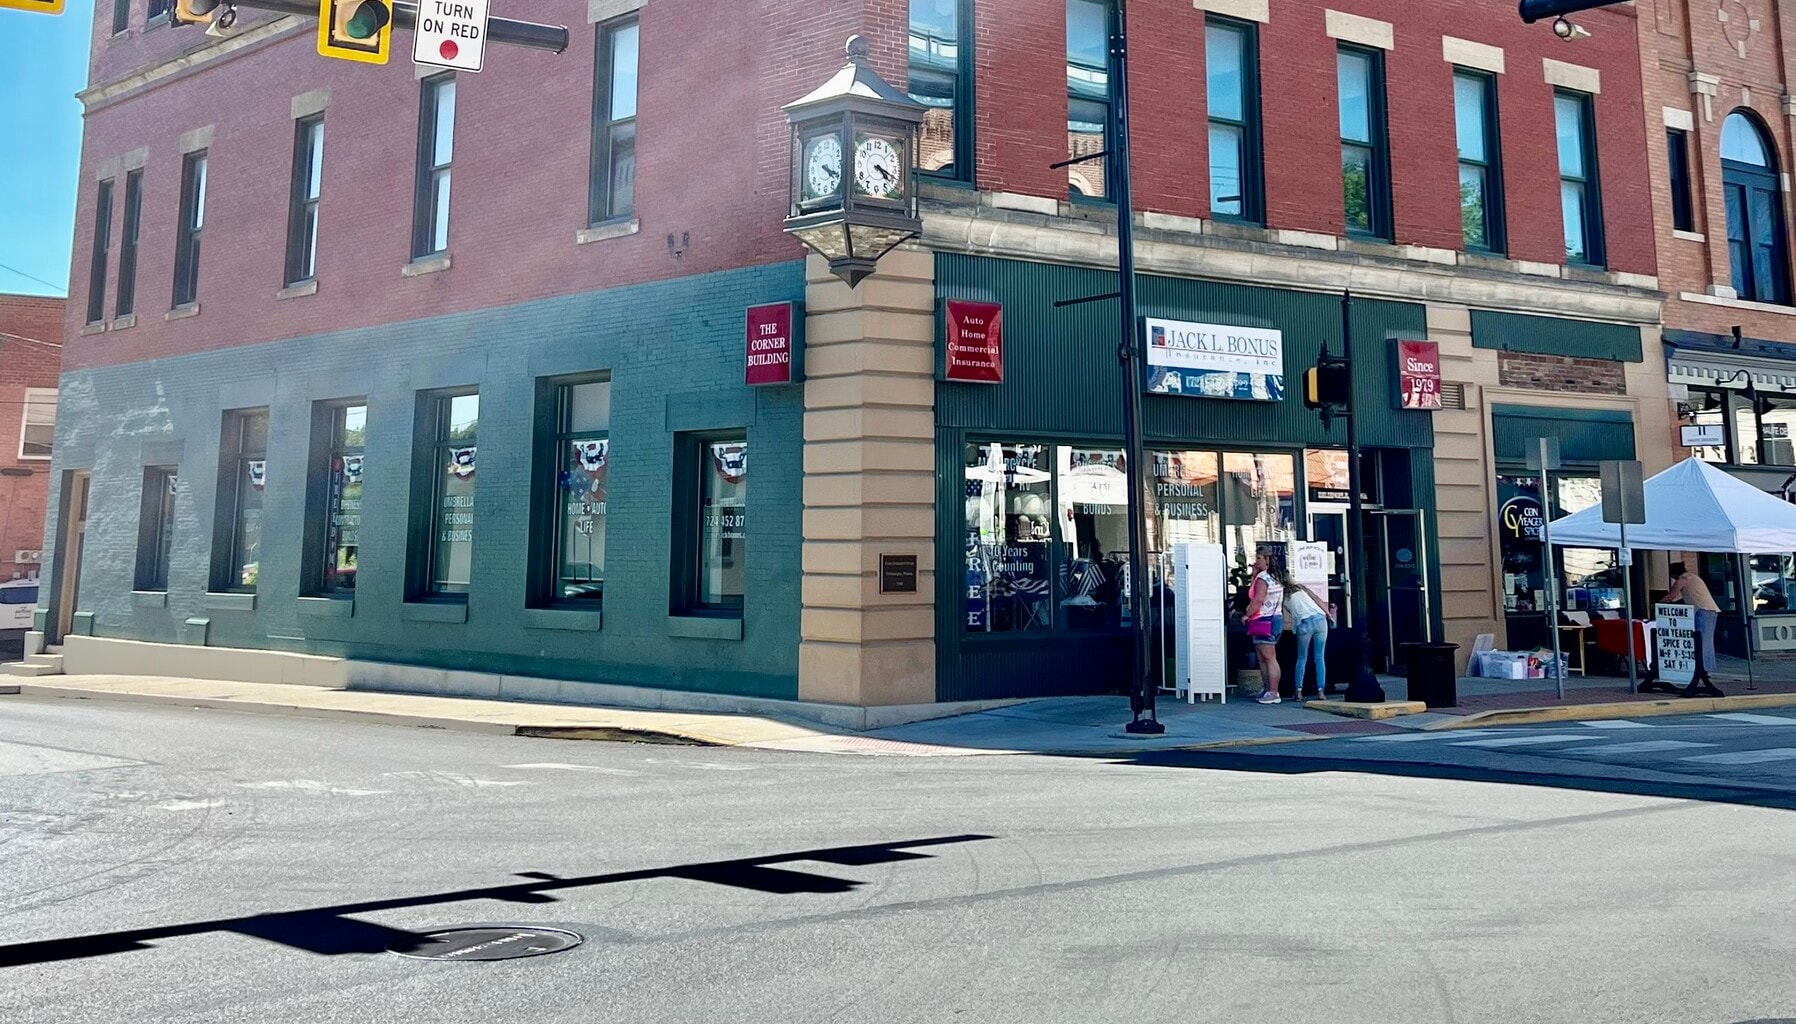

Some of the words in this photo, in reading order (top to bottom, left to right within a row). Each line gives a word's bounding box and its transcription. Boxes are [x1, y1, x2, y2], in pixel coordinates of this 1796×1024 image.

[435, 1, 473, 19] TURN
[423, 19, 443, 34] ON
[451, 23, 479, 39] RED
[963, 316, 984, 325] Auto
[760, 323, 777, 335] THE
[961, 329, 986, 340] Home
[751, 337, 786, 351] CORNER
[948, 342, 999, 355] Commercial
[1168, 330, 1208, 351] JACK
[1211, 334, 1224, 352] L.
[1227, 335, 1278, 357] BONUS
[748, 352, 788, 367] BUILDING
[951, 356, 995, 368] Insurance
[1407, 357, 1434, 372] Since
[1411, 378, 1434, 393] 1979
[978, 457, 1037, 471] MRCYCLE
[1158, 483, 1204, 497] PERSONAL
[567, 502, 585, 515] HOME
[1083, 503, 1112, 515] BONDS
[1154, 504, 1161, 516] &
[1164, 503, 1208, 517] BUSINESS
[1523, 507, 1539, 517] CON
[580, 520, 593, 534] LIFE
[705, 515, 719, 527] 724
[735, 515, 745, 527] 87
[1519, 517, 1543, 526] YEAGER
[441, 531, 447, 542] &
[1002, 545, 1029, 557] Years
[992, 559, 1034, 574] Counting
[1658, 608, 1688, 617] WELCOME
[1669, 618, 1677, 627] TO
[1657, 628, 1669, 637] CON
[1671, 629, 1695, 638] YEAGER
[1663, 638, 1680, 648] SPICE
[1659, 649, 1671, 658] M-F
[1664, 660, 1675, 669] SAT
[1679, 661, 1688, 669] 9-1
